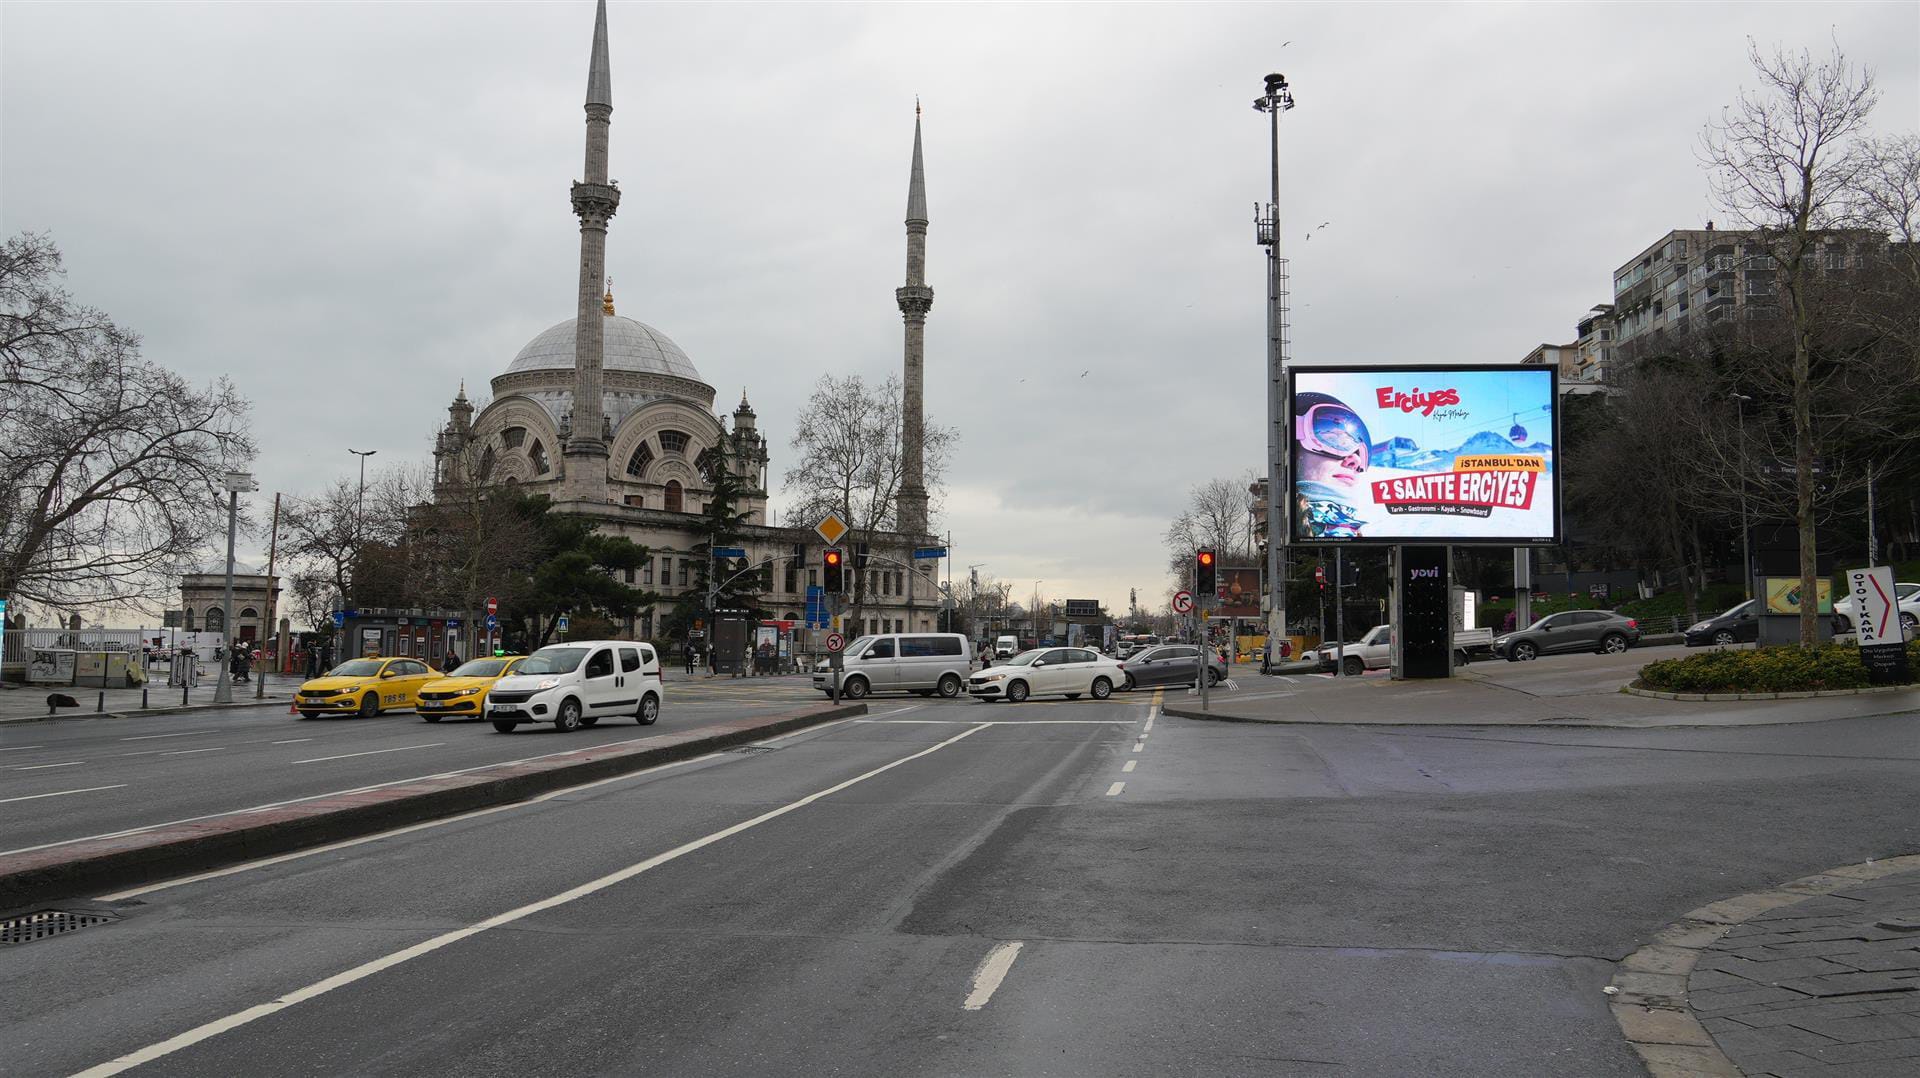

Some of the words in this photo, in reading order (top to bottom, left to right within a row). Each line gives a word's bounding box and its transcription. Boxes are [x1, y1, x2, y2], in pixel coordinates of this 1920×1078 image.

[1376, 386, 1460, 418] Erciyes
[1379, 481, 1392, 500] 2
[1393, 474, 1456, 501] SAATTE
[1440, 505, 1456, 514] Kayak
[1460, 506, 1488, 516] Snowboard
[1410, 566, 1439, 580] yovi
